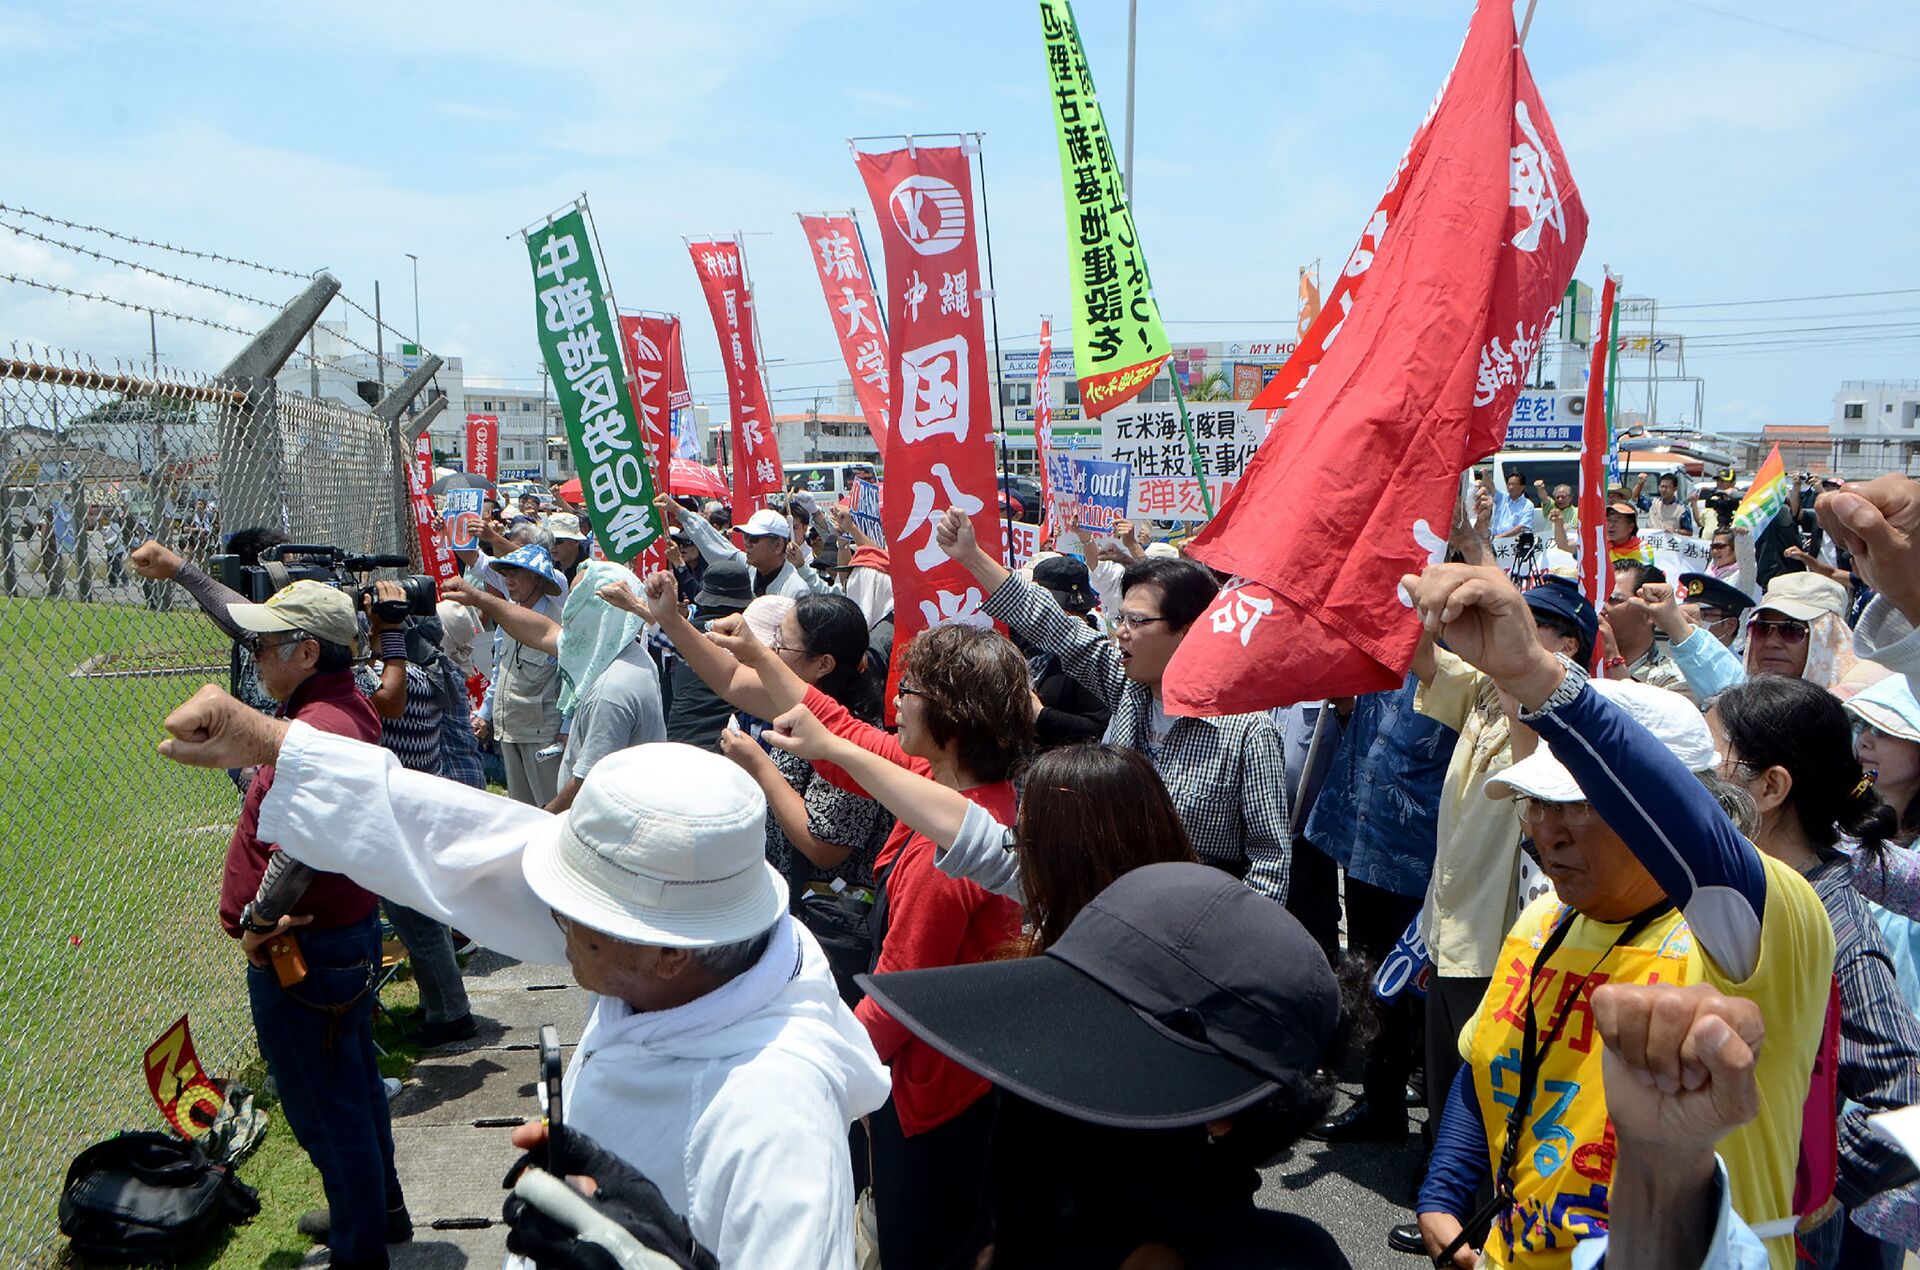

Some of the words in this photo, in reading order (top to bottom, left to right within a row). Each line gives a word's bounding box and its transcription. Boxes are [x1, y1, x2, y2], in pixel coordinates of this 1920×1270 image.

[902, 270, 970, 321] 沖縄
[815, 230, 890, 430] 琉大学
[1250, 343, 1271, 354] MY
[1515, 396, 1556, 421] 空を!
[1090, 466, 1127, 497] out!
[1079, 496, 1124, 528] rines
